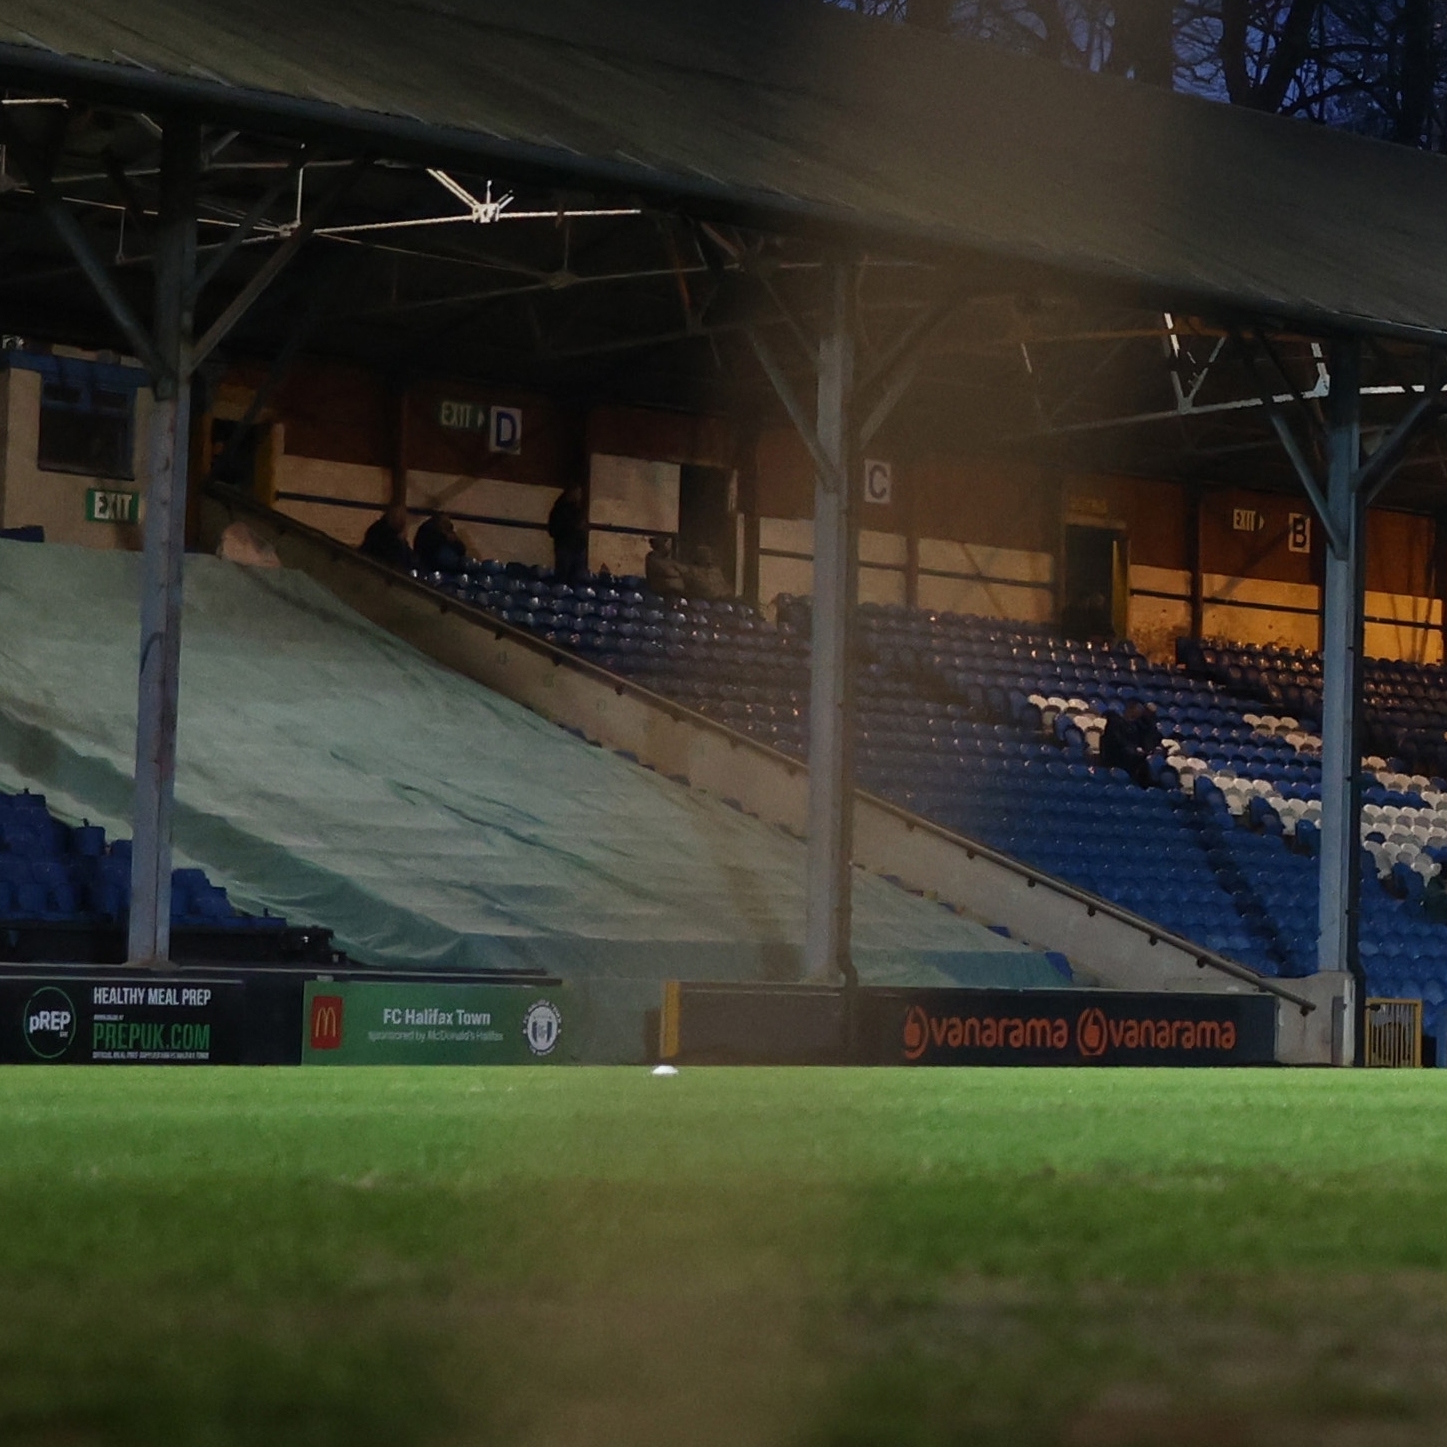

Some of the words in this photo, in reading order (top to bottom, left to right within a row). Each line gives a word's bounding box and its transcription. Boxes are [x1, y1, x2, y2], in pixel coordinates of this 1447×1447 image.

[441, 401, 472, 428] EXIT
[496, 411, 516, 448] D
[869, 465, 888, 499] C
[94, 491, 132, 520] EXIT
[1233, 509, 1256, 531] EXIT
[1293, 518, 1306, 548] B
[93, 987, 146, 1005] HEALTHY
[147, 988, 180, 1005] MEAL
[181, 989, 212, 1006] PREP
[29, 1011, 71, 1034] pREP
[383, 1008, 402, 1025] FC
[405, 1008, 453, 1025] Halifax
[456, 1009, 491, 1025] Town
[93, 1023, 211, 1051] PREPUK.COM
[930, 1017, 1069, 1049] vanarama
[1109, 1019, 1237, 1049] vanarama
